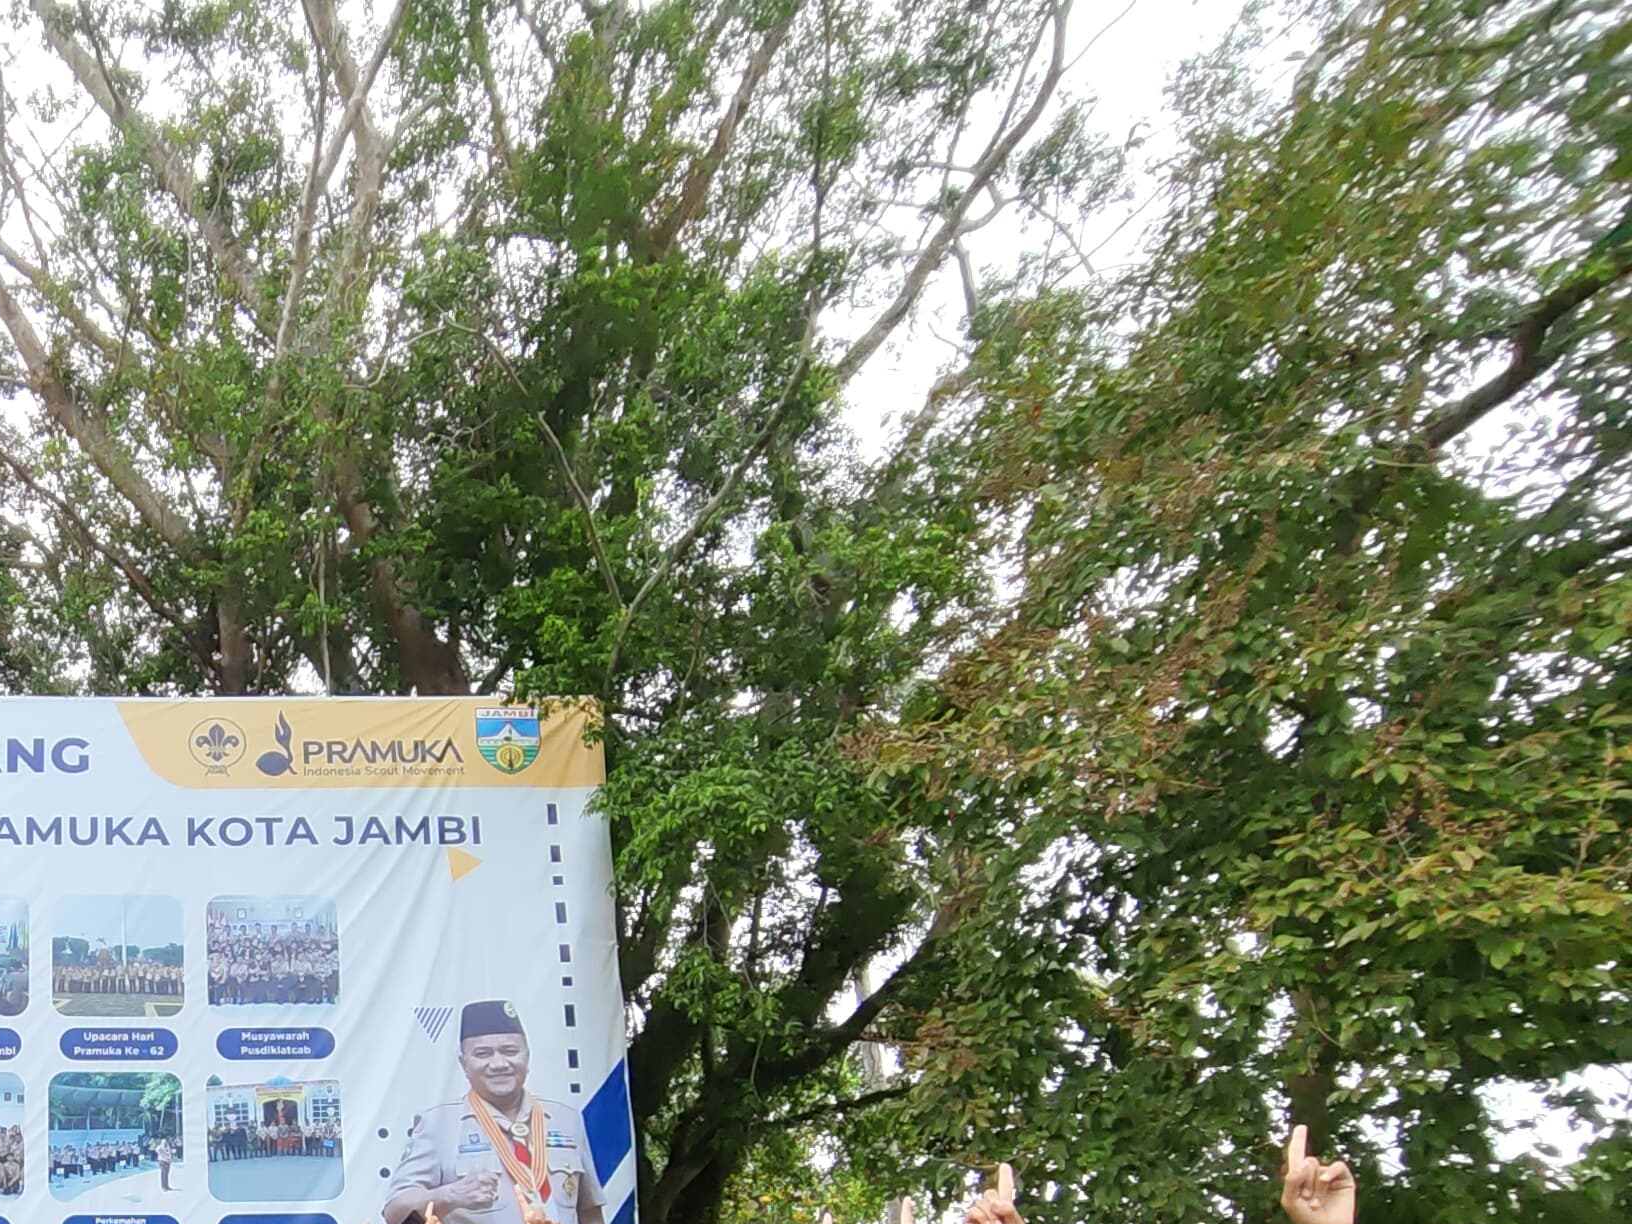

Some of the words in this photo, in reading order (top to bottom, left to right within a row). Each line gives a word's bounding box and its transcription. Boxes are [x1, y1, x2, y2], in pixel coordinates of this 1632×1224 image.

[303, 736, 464, 764] PRAMUKA
[303, 767, 361, 777] Indonesia
[365, 767, 399, 777] Scout
[402, 767, 464, 777] Movement
[187, 816, 320, 846] KOTA
[332, 815, 482, 846] JAMBI
[83, 1031, 129, 1042] Upacara
[131, 1031, 155, 1041] Hari
[241, 1031, 310, 1042] Musyawarah
[73, 1046, 122, 1056] Pramuka
[124, 1046, 140, 1055] Ke
[149, 1046, 164, 1055] 62
[240, 1045, 312, 1055] Pusdiklatcab
